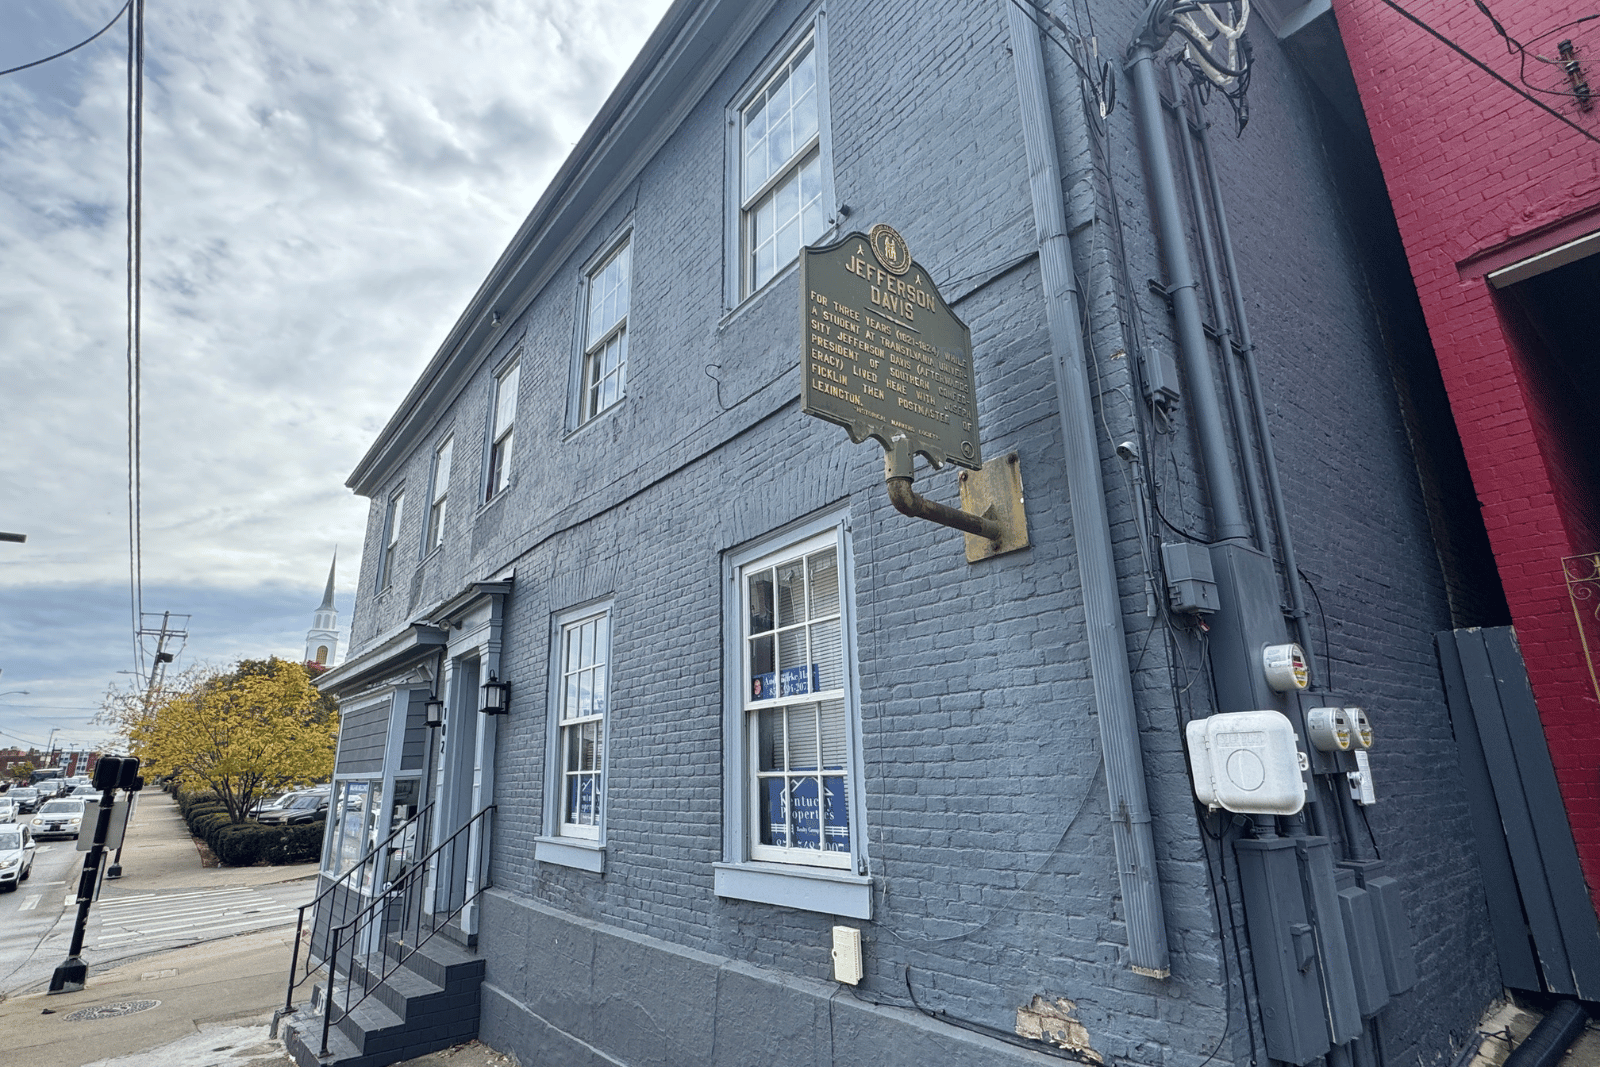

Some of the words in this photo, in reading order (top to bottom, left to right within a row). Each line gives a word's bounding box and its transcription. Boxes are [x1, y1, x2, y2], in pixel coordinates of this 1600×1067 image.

[845, 255, 936, 313] JEFFERSON
[871, 285, 914, 321] DAVIS
[811, 290, 828, 307] FOR
[833, 301, 860, 322] THREE
[865, 316, 892, 335] YEARS
[896, 330, 939, 357] (1821-1824)
[944, 352, 967, 369] WHILE
[811, 305, 818, 316] A
[823, 311, 860, 334] STUDENT
[865, 330, 875, 342] AT
[938, 361, 968, 380] UNIVER-
[811, 319, 831, 335] SITY
[837, 332, 885, 359] JEFFERSON
[890, 353, 911, 371] DAVIS
[916, 364, 969, 394] (AFTERWARDS
[811, 333, 859, 361] PRESIDENT
[869, 358, 880, 370] OF
[890, 367, 930, 391] SOUTHERN
[938, 386, 970, 405] CONFED-
[811, 348, 844, 371] ERACY)
[853, 365, 878, 383] LIVED
[886, 378, 907, 396] HERE
[916, 390, 936, 406] WITH
[944, 402, 971, 419] JOSEPH
[812, 378, 864, 407] LEXINGTON.
[812, 363, 848, 386] FICKLIN
[863, 383, 884, 400] THEN
[898, 397, 950, 425] POSTMASTER
[962, 420, 972, 432] OF
